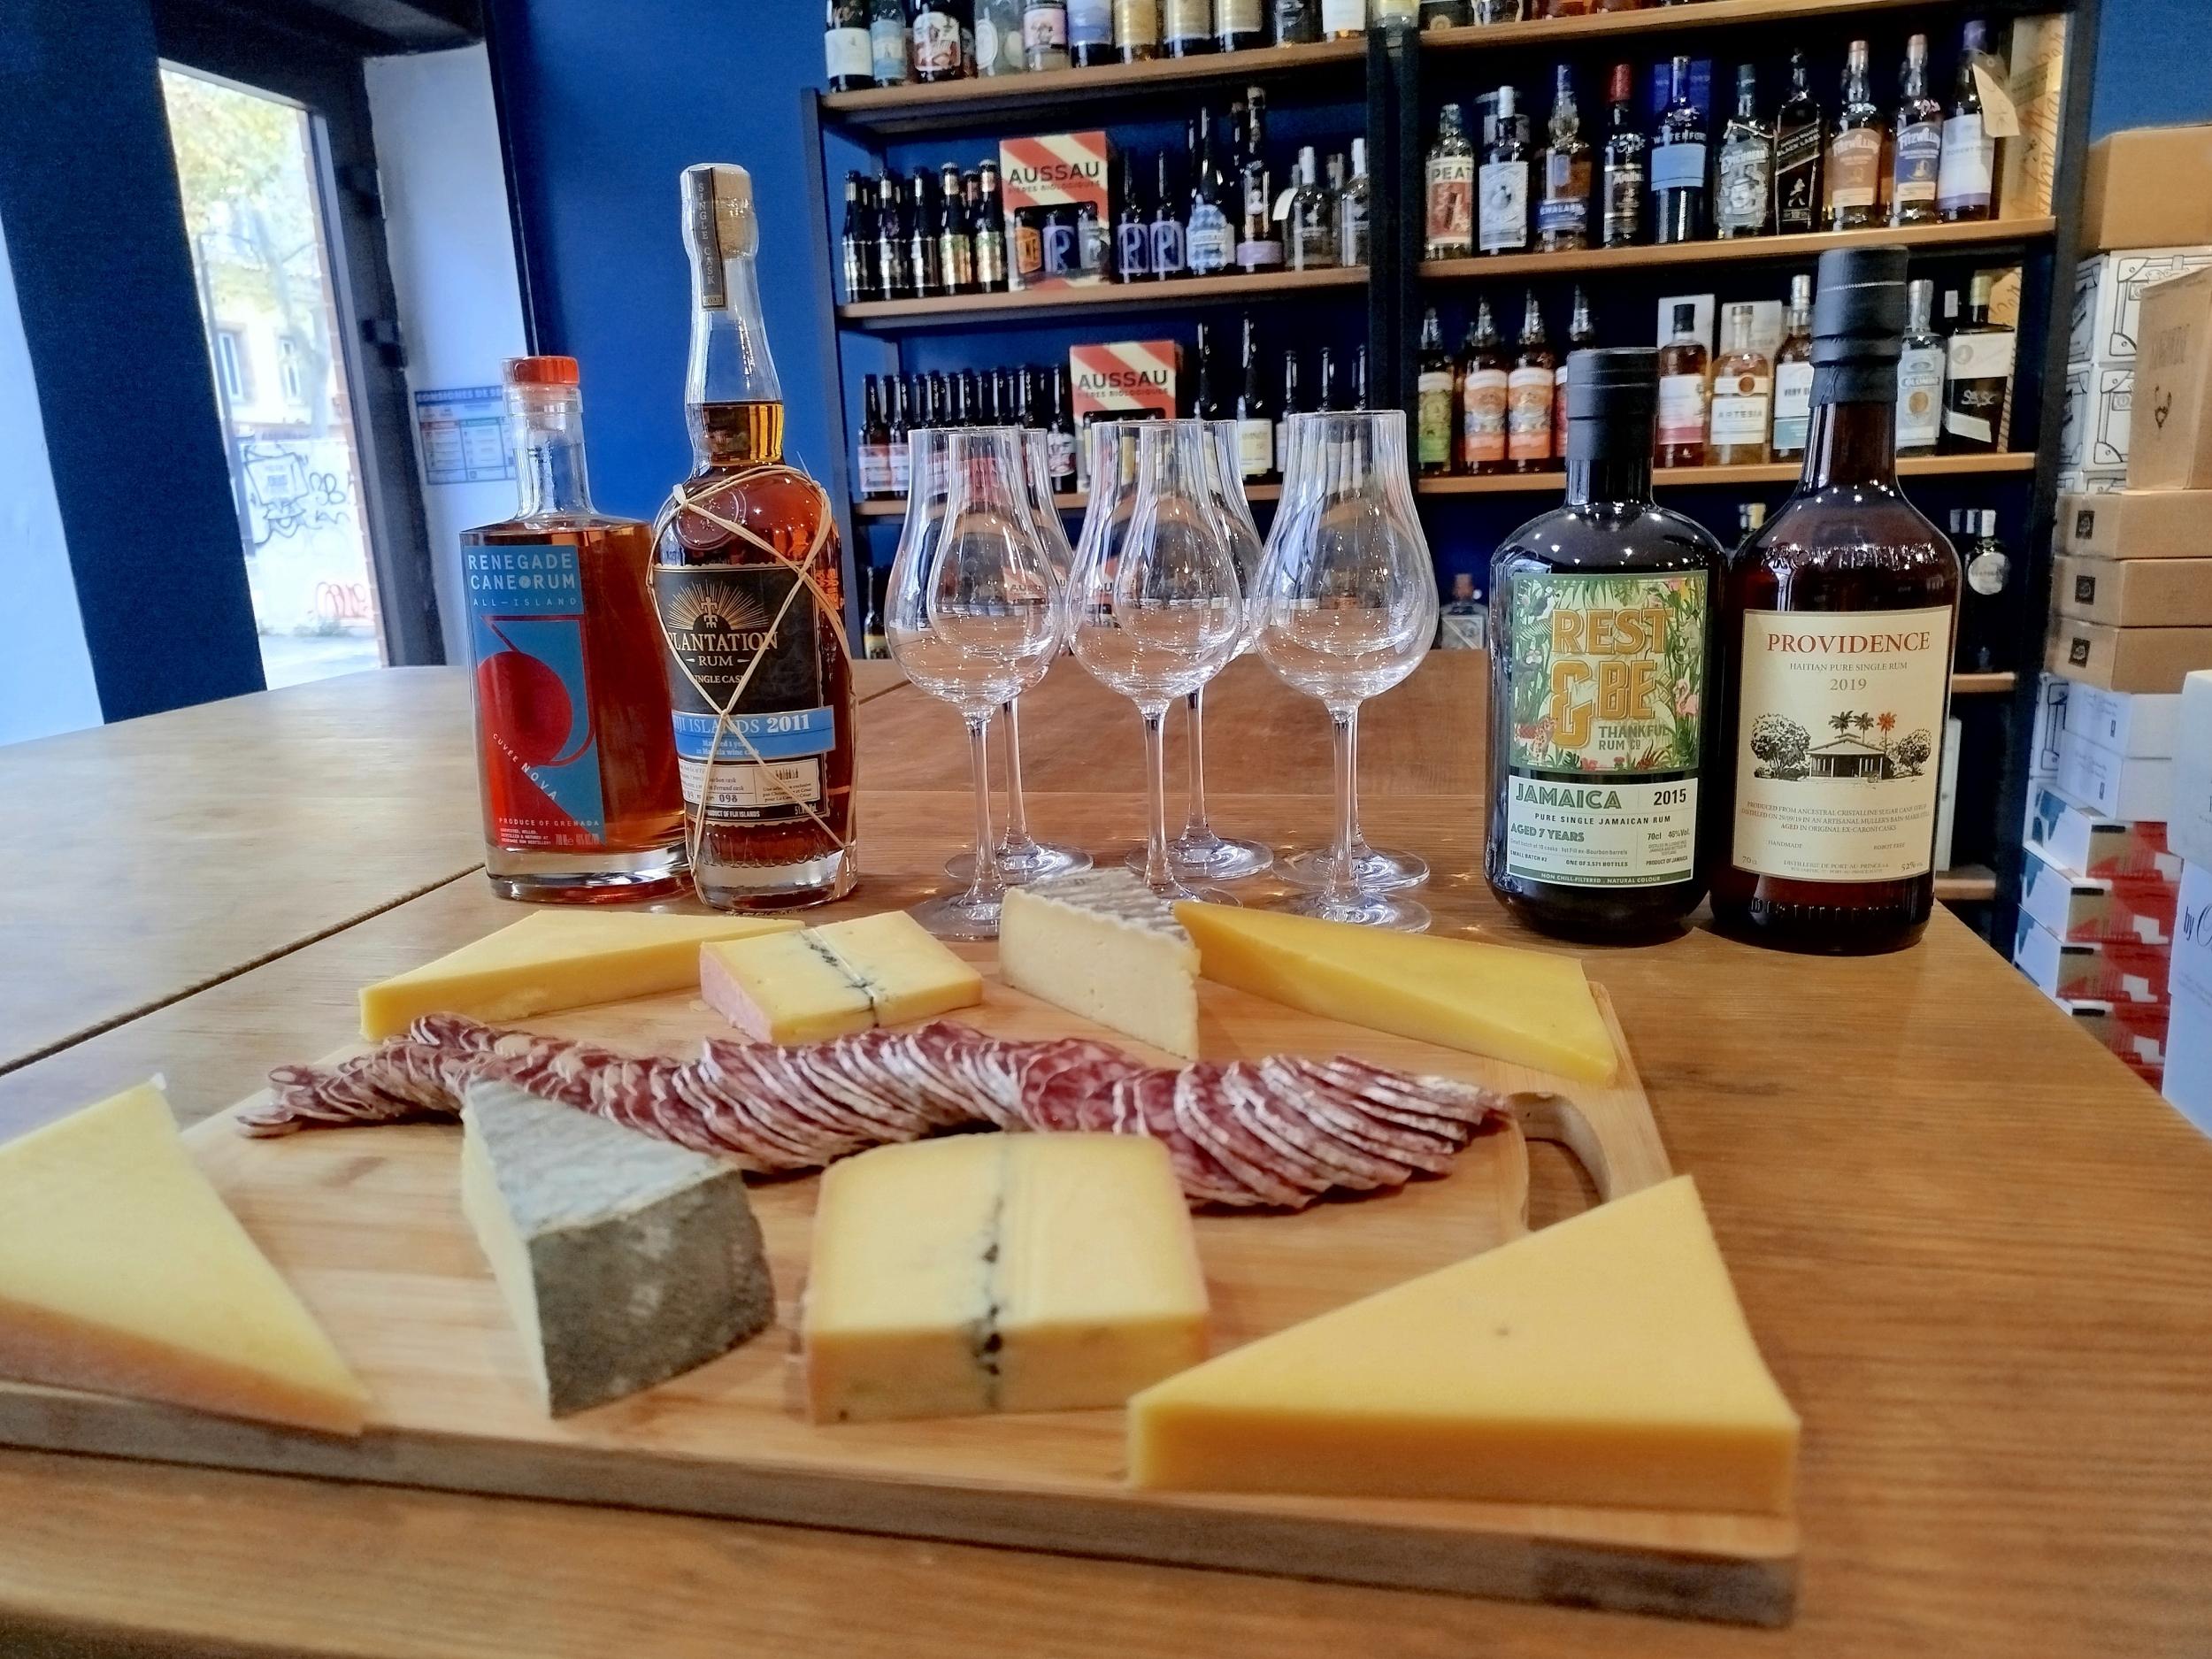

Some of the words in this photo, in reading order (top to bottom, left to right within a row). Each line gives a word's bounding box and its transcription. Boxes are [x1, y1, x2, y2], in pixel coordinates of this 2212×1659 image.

[1010, 162, 1100, 184] AUSSAU
[698, 183, 709, 240] SINGLE
[703, 246, 716, 284] CASK
[1079, 369, 1167, 390] AUSSAU
[467, 553, 572, 571] RENEGADE
[471, 574, 517, 591] CANE
[534, 573, 575, 590] RUM
[1552, 608, 1674, 656] REST
[1767, 632, 1931, 654] PROVIDENCE
[698, 656, 733, 666] RUM
[1790, 663, 1827, 672] HAITIAN
[695, 674, 721, 684] INGLE
[1830, 678, 1867, 691] 2019
[1598, 660, 1657, 720] BE
[689, 718, 760, 733] ISLADS
[766, 714, 810, 733] 2011
[1598, 725, 1670, 739] THANKFUL
[1599, 740, 1624, 750] RUM
[521, 762, 557, 801] NOVA
[718, 794, 738, 803] 098
[1516, 783, 1622, 810] JAMAICA
[1654, 788, 1686, 806] 2015
[1741, 808, 1768, 818] DISTILLED
[1747, 801, 1778, 811] PRODUCED
[499, 817, 535, 826] PRODUCE
[1534, 812, 1556, 822] PURE
[1560, 816, 1594, 825] SINGLE
[1598, 817, 1649, 826] JAMAICAN
[1653, 815, 1671, 824] RUM
[1510, 823, 1537, 837] AGED
[1538, 828, 1546, 838] 7
[1547, 829, 1585, 842] YEARS
[1647, 831, 1662, 841] 70cl
[1768, 840, 1802, 849] HANDMADE
[2183, 906, 2194, 941] by
